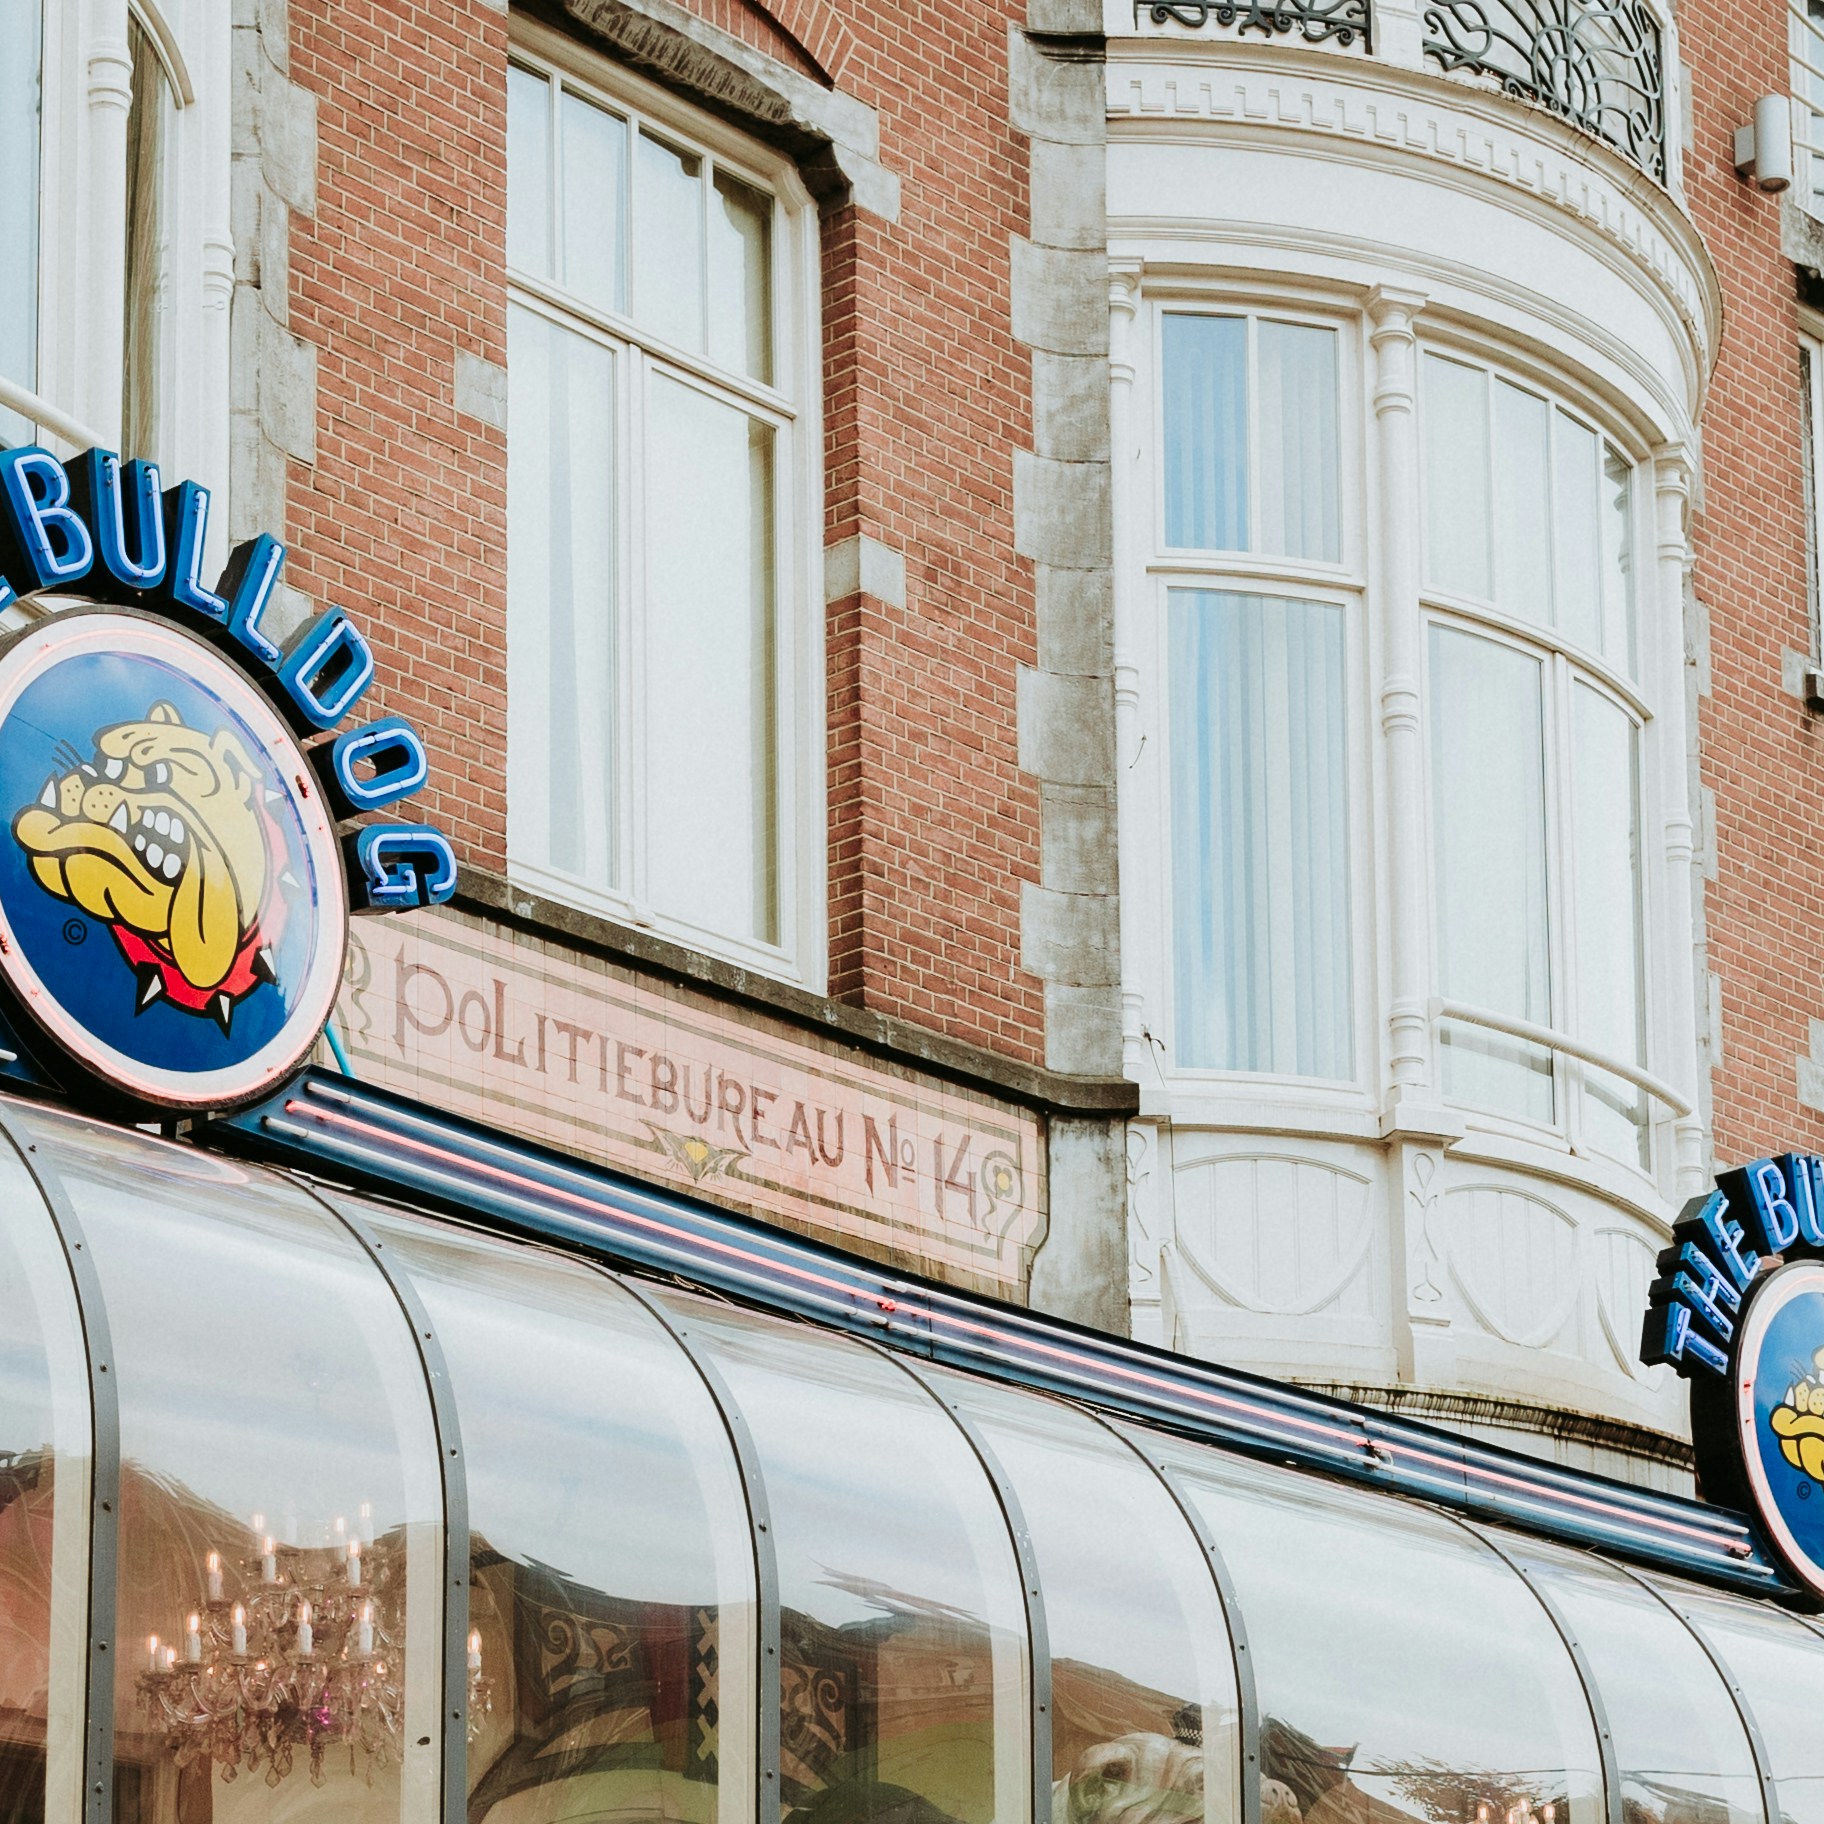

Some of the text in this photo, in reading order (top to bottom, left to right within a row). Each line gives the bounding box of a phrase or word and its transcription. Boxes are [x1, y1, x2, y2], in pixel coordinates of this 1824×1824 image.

[394, 941, 846, 1168] POLITIEBUREAU
[933, 1132, 977, 1229] 14
[1644, 1189, 1762, 1378] THE
